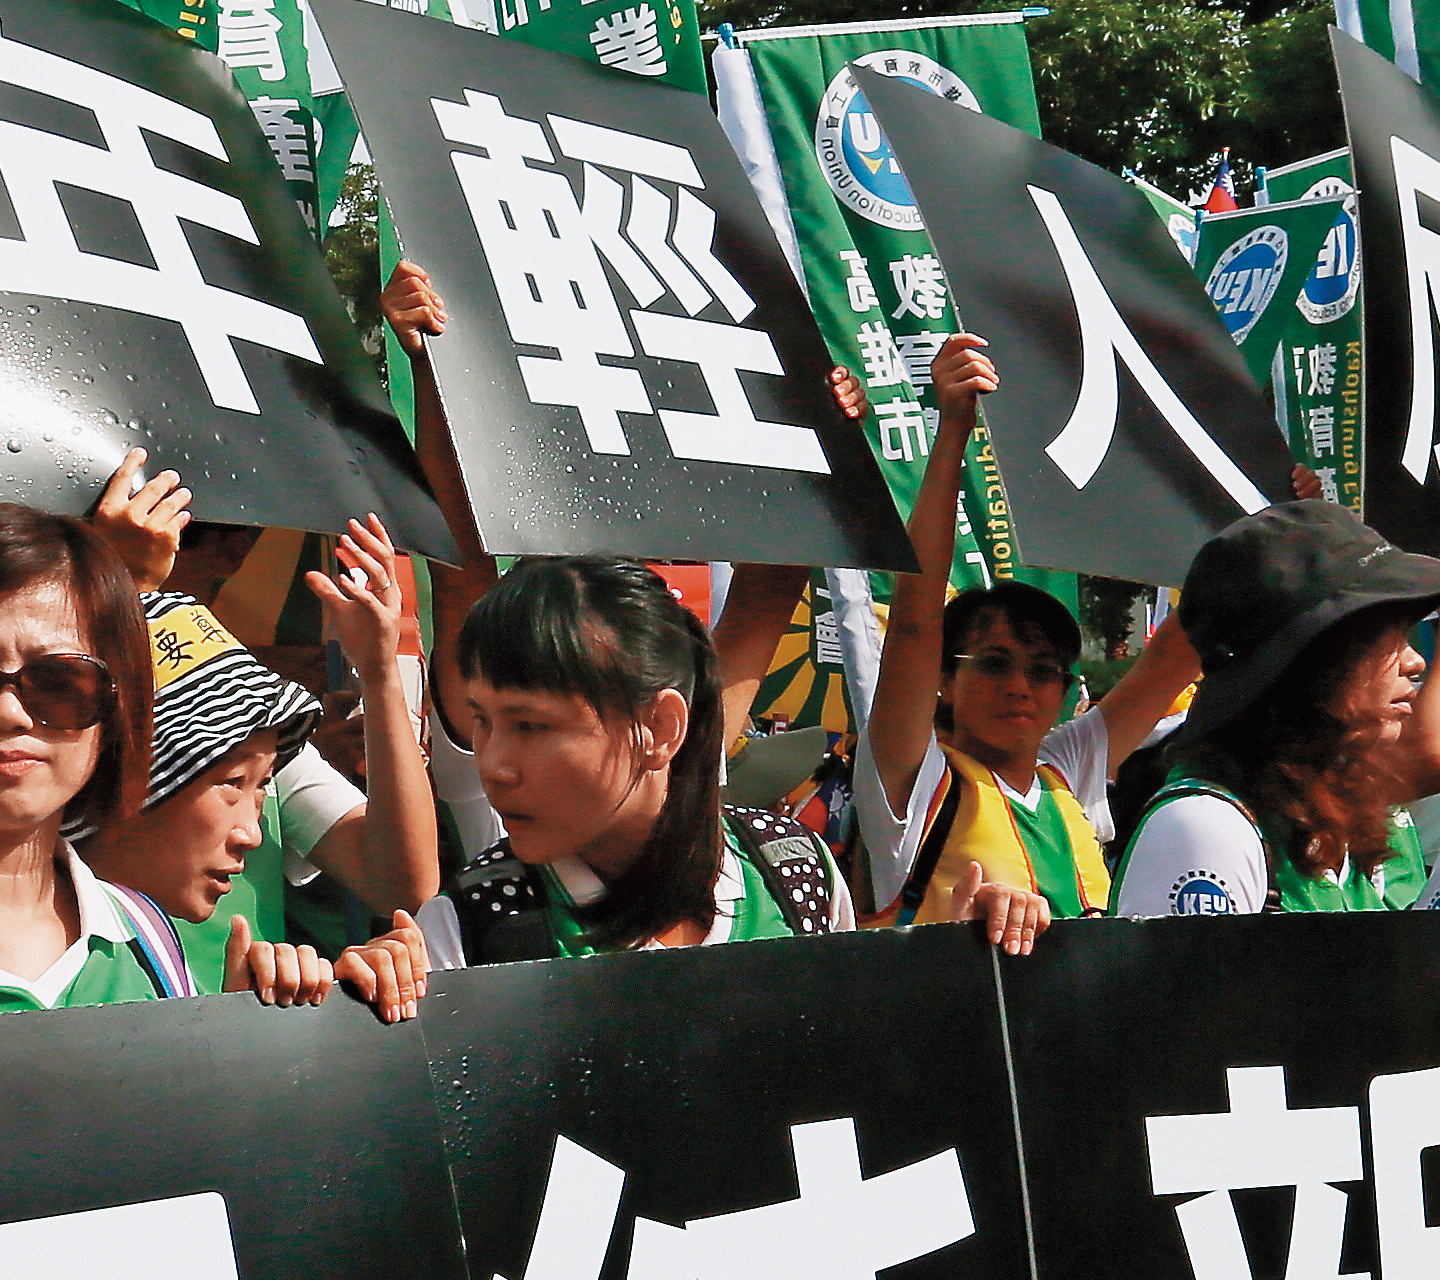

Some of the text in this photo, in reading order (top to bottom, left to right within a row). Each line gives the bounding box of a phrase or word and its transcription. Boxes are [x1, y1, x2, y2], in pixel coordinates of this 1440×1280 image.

[431, 89, 831, 475] 輕
[1027, 185, 1271, 515] 人
[1183, 893, 1227, 915] KEU
